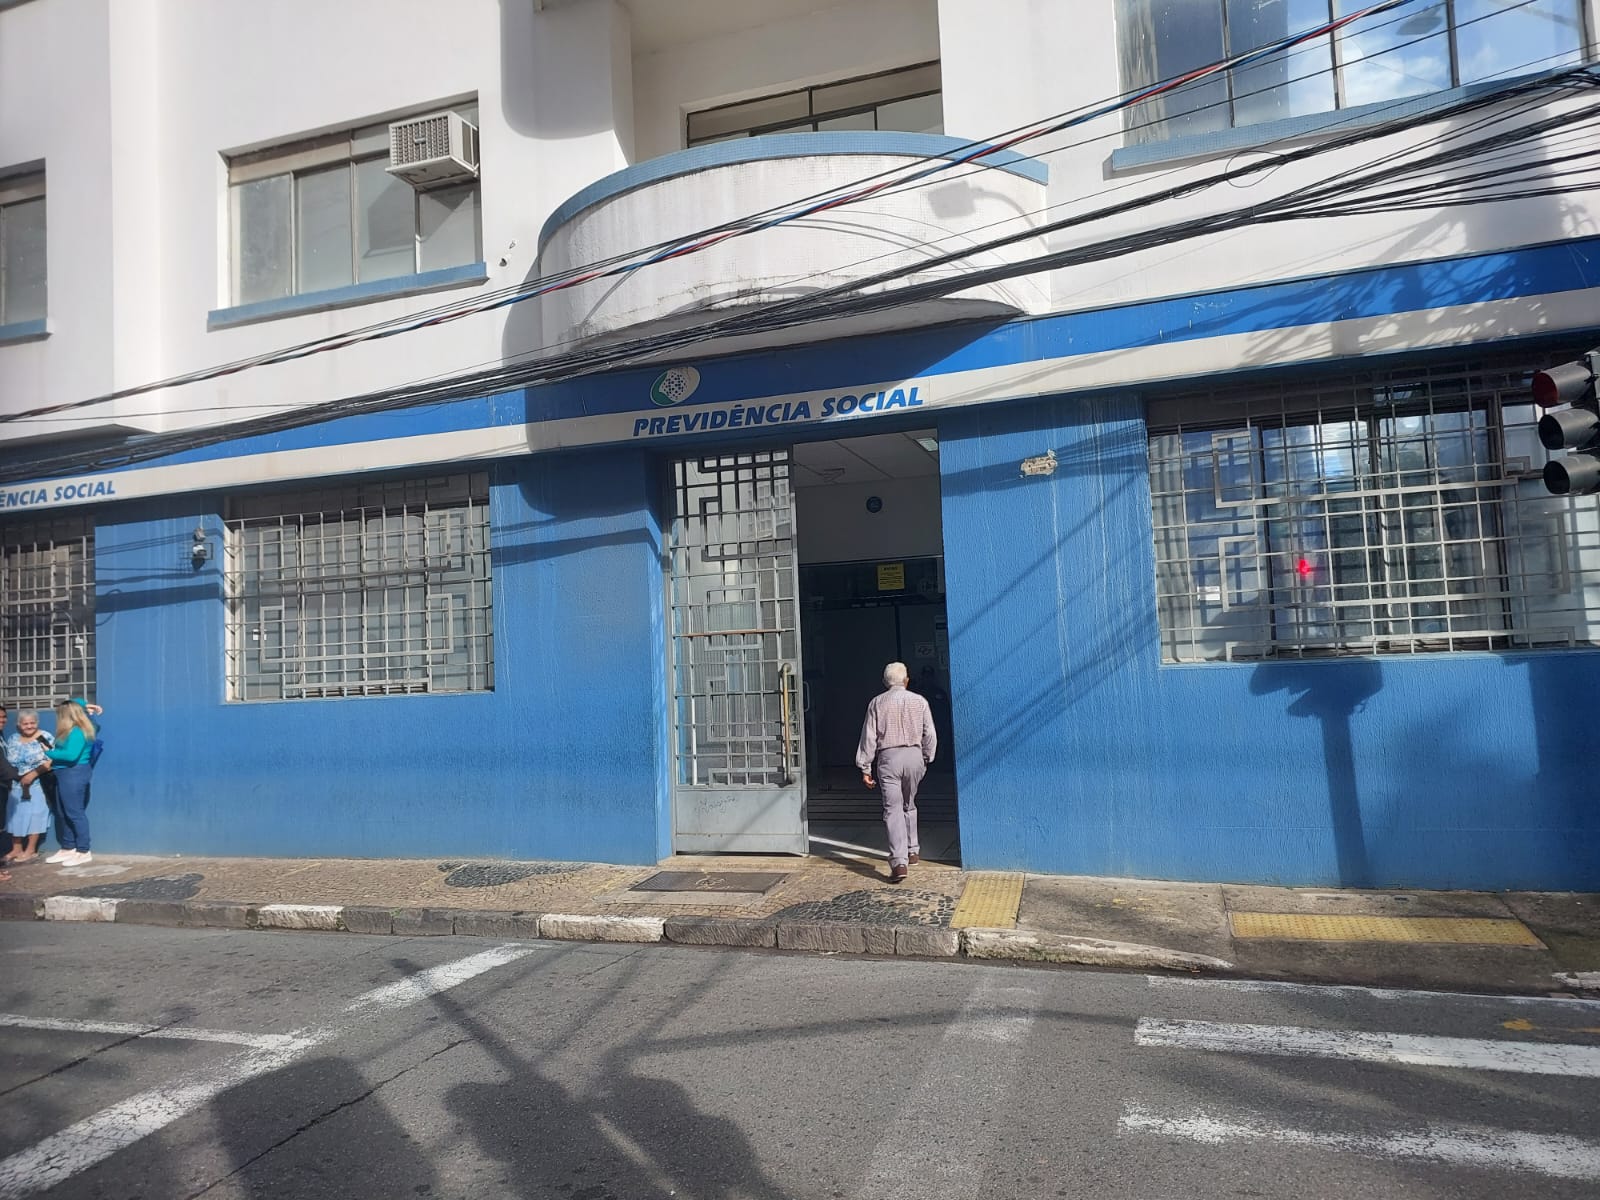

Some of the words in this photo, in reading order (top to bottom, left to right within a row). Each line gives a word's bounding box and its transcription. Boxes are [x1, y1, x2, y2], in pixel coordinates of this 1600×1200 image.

[633, 400, 811, 437] PREVIDÊNCIA
[821, 387, 923, 417] SOCIAL
[54, 480, 115, 501] SOCIAL
